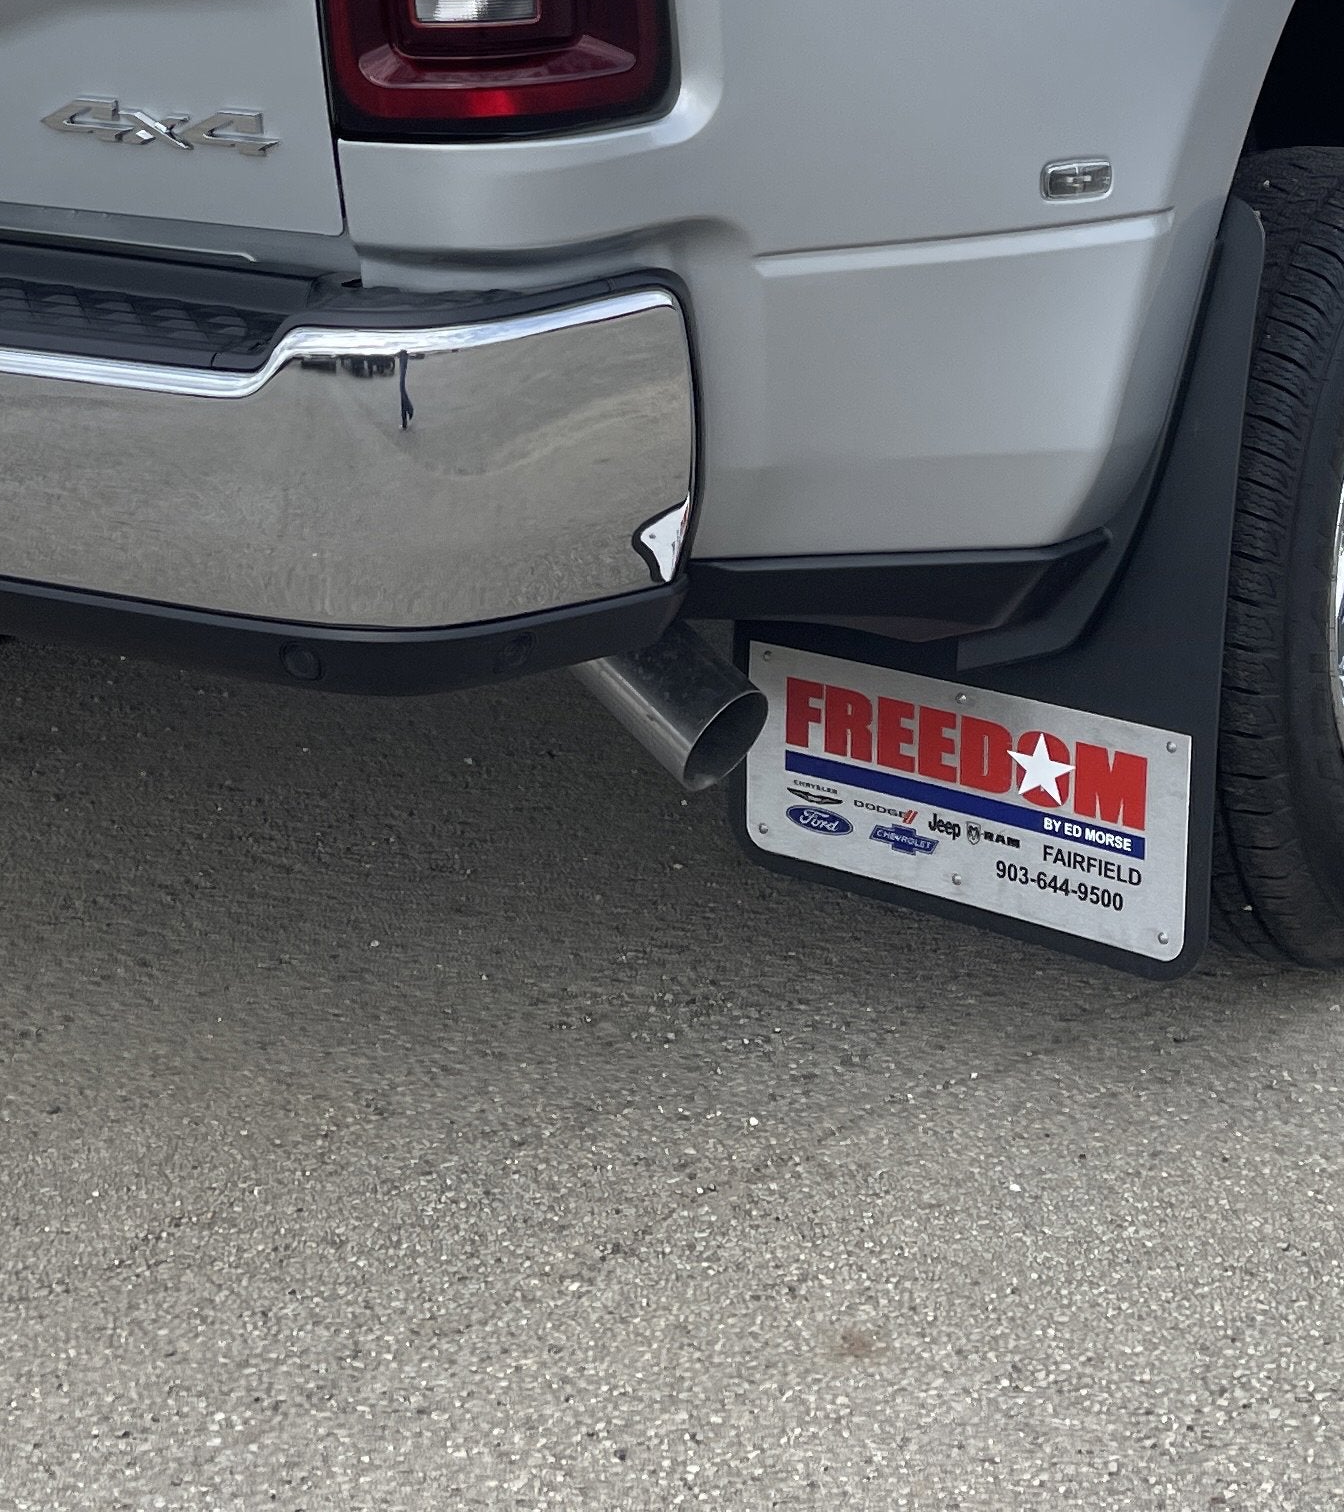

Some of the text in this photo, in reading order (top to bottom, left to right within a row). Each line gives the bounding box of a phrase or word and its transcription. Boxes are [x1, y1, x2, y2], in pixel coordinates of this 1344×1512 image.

[786, 677, 1148, 831] FREEDOM
[793, 779, 838, 795] CHRYSLER
[799, 810, 839, 832] Ford
[928, 813, 961, 840] Jeep
[1043, 817, 1133, 851] BY ED MORSE
[876, 829, 933, 850] CHEVROLET
[984, 831, 1021, 849] RAM
[1042, 844, 1142, 886] FAIRFIELD
[996, 860, 1124, 912] 903-644-9500
